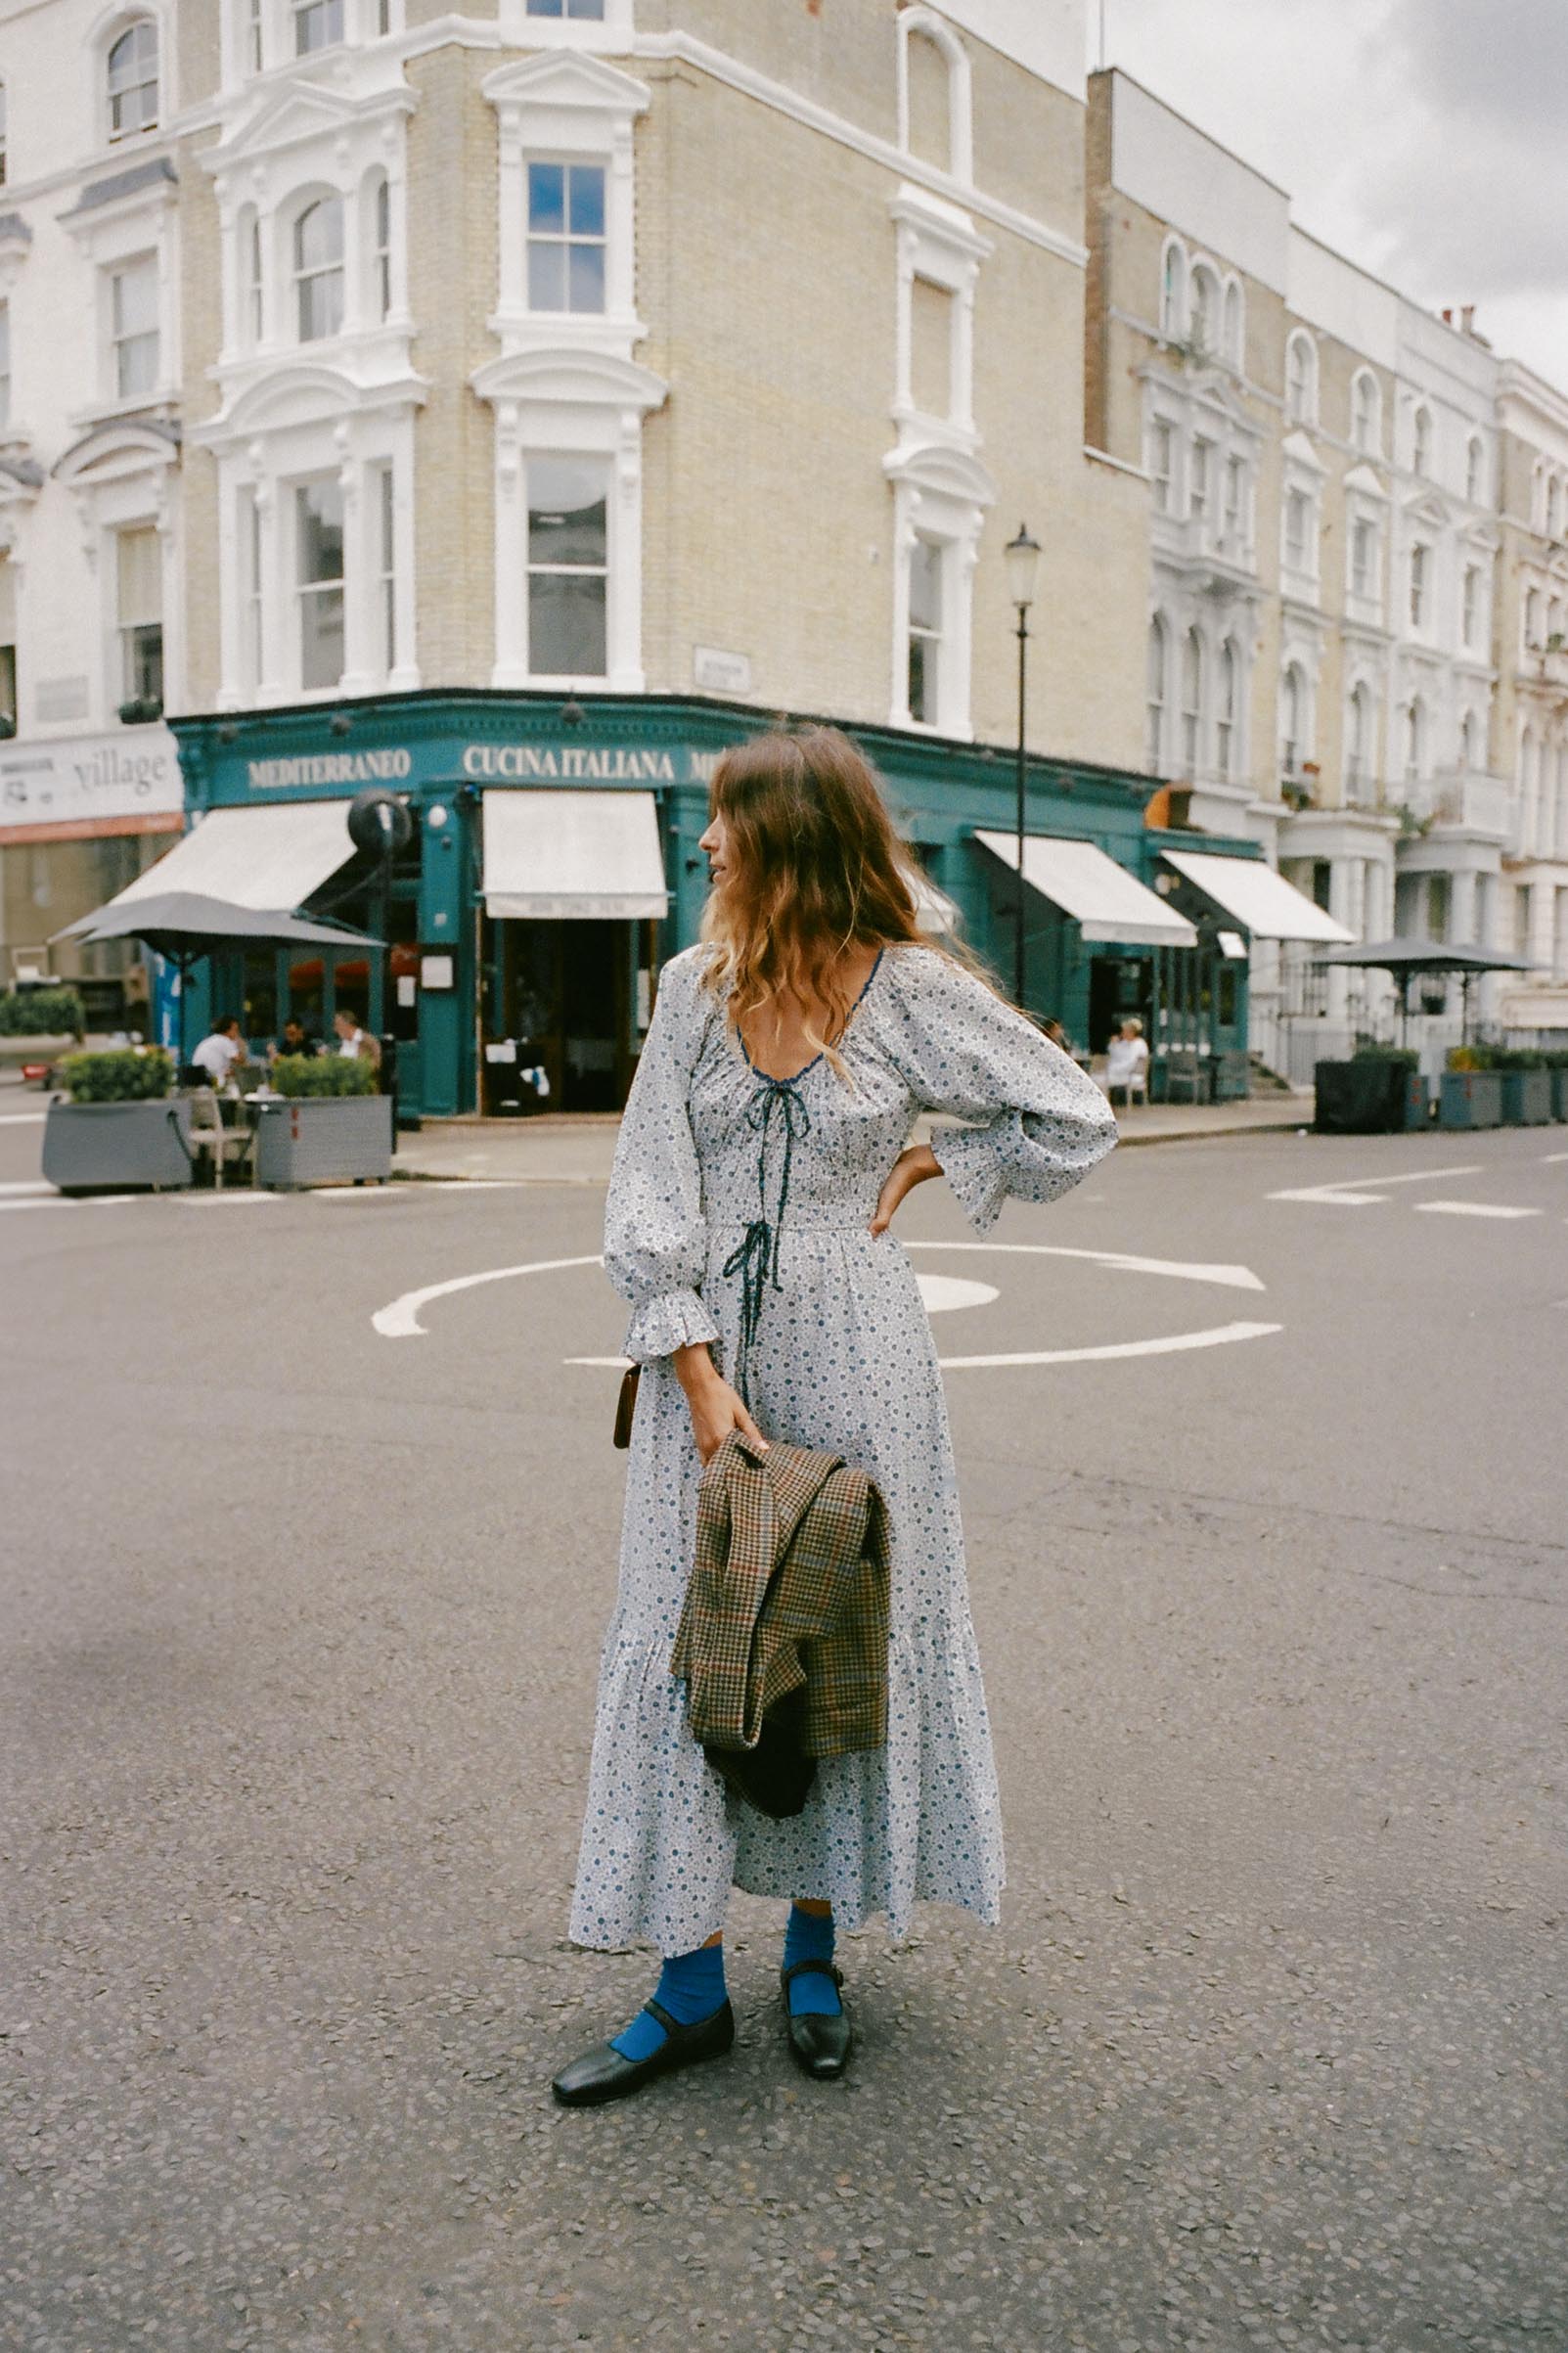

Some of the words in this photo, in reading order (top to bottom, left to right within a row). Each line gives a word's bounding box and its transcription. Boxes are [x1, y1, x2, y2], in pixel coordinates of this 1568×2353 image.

[74, 748, 166, 796] village
[248, 748, 411, 788] MEDITERRANEO
[463, 745, 558, 777] CUCINA
[561, 747, 675, 779] ITALIANA
